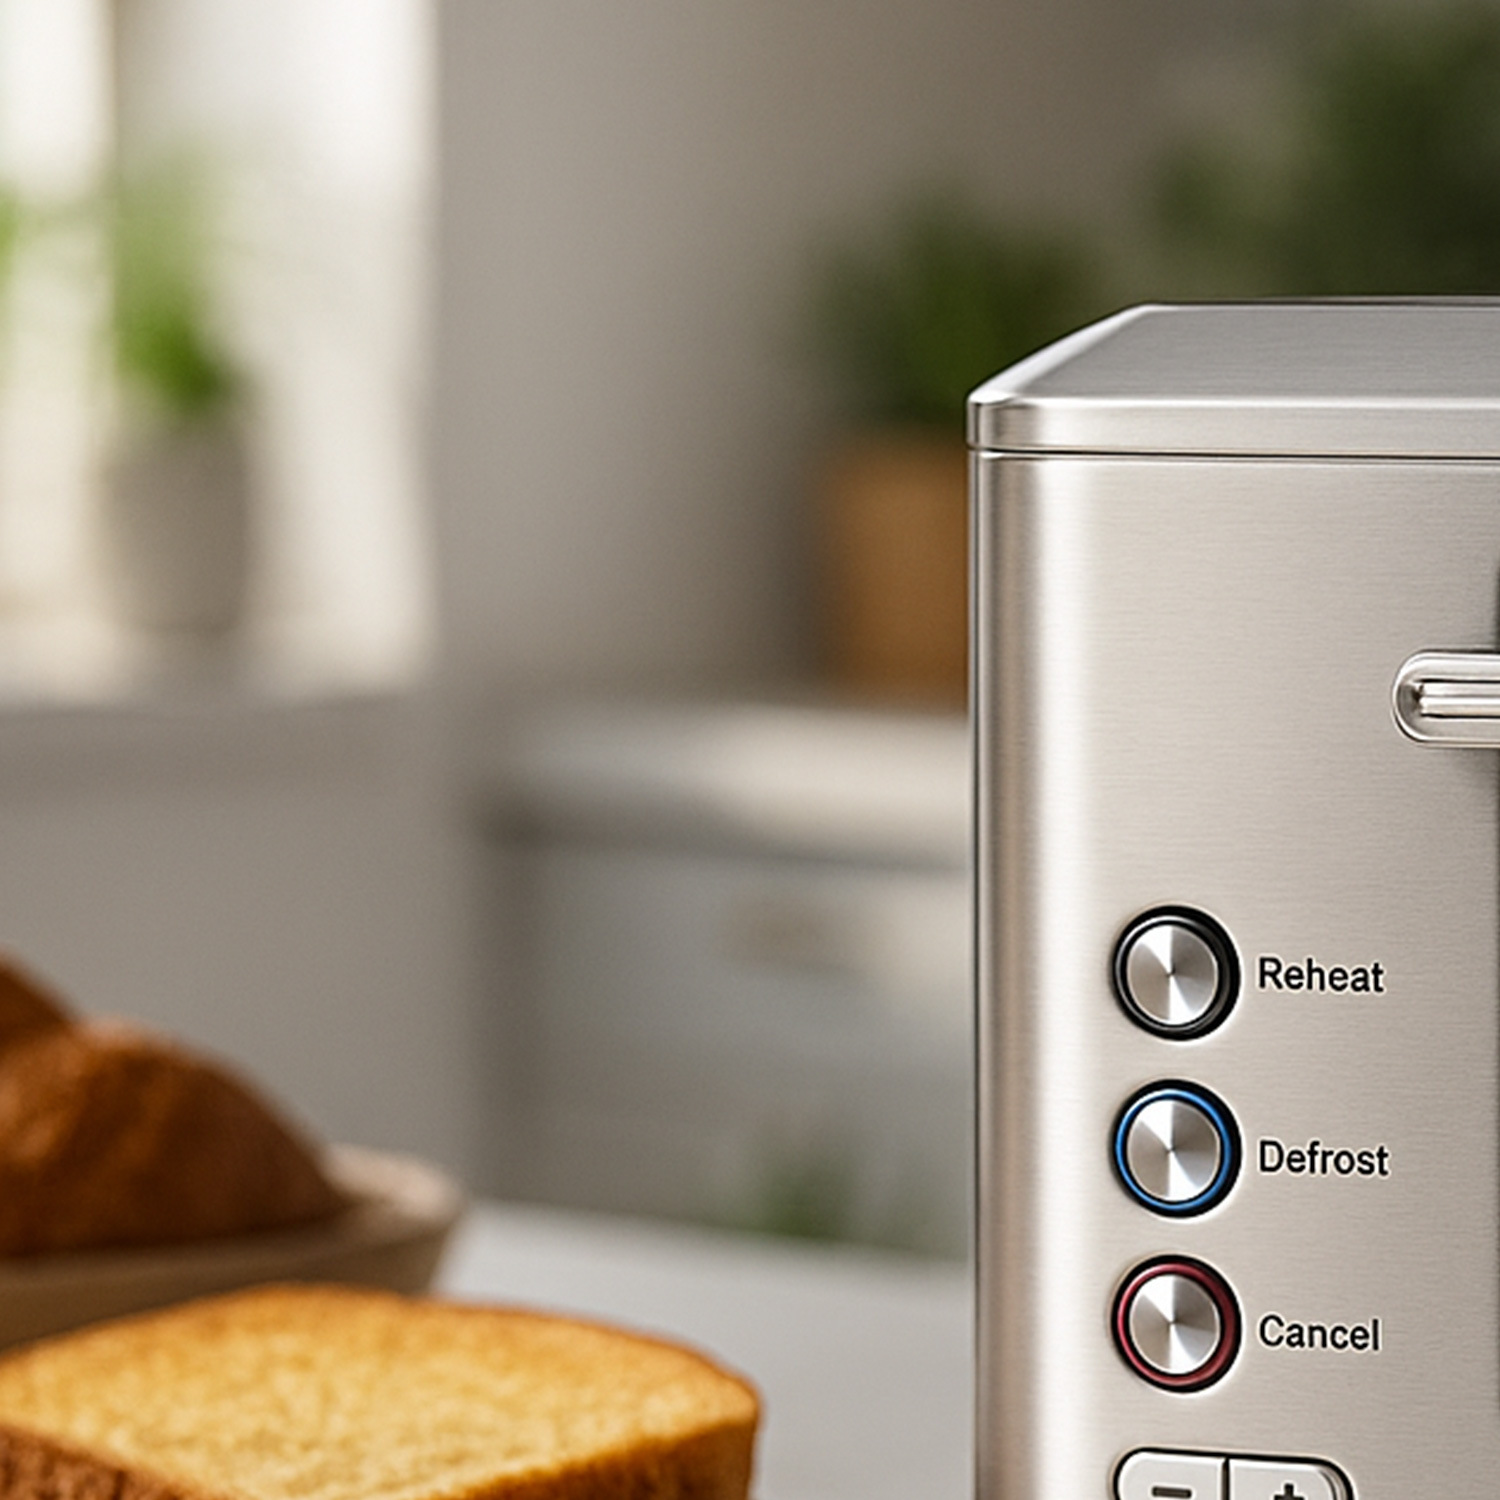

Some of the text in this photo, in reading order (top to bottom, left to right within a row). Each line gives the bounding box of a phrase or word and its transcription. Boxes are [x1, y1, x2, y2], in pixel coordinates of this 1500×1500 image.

[1258, 957, 1384, 993] Reheat
[1259, 1140, 1390, 1176] Defrost
[1259, 1314, 1380, 1351] Cancel
